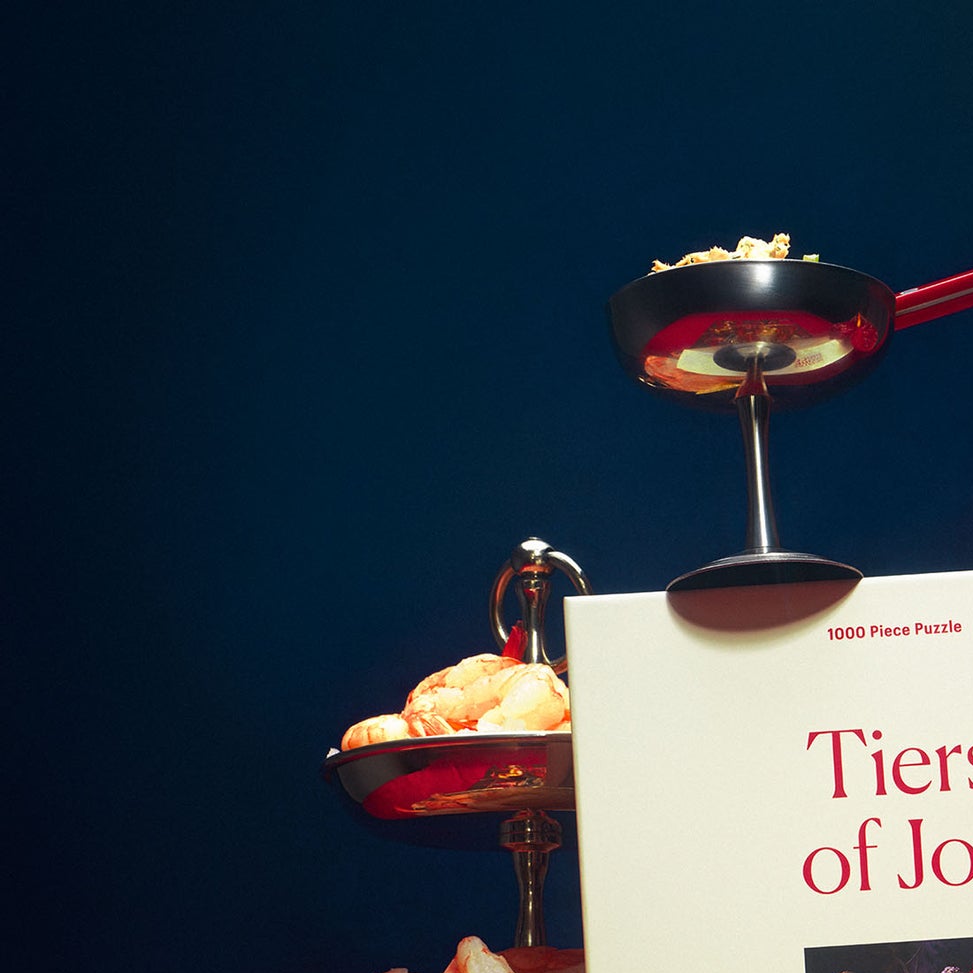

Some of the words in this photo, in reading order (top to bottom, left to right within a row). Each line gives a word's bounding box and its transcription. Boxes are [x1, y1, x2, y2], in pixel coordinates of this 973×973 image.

[827, 626, 866, 641] 1000
[870, 625, 911, 638] Piece
[914, 620, 963, 635] Puzzle
[802, 817, 882, 895] of
